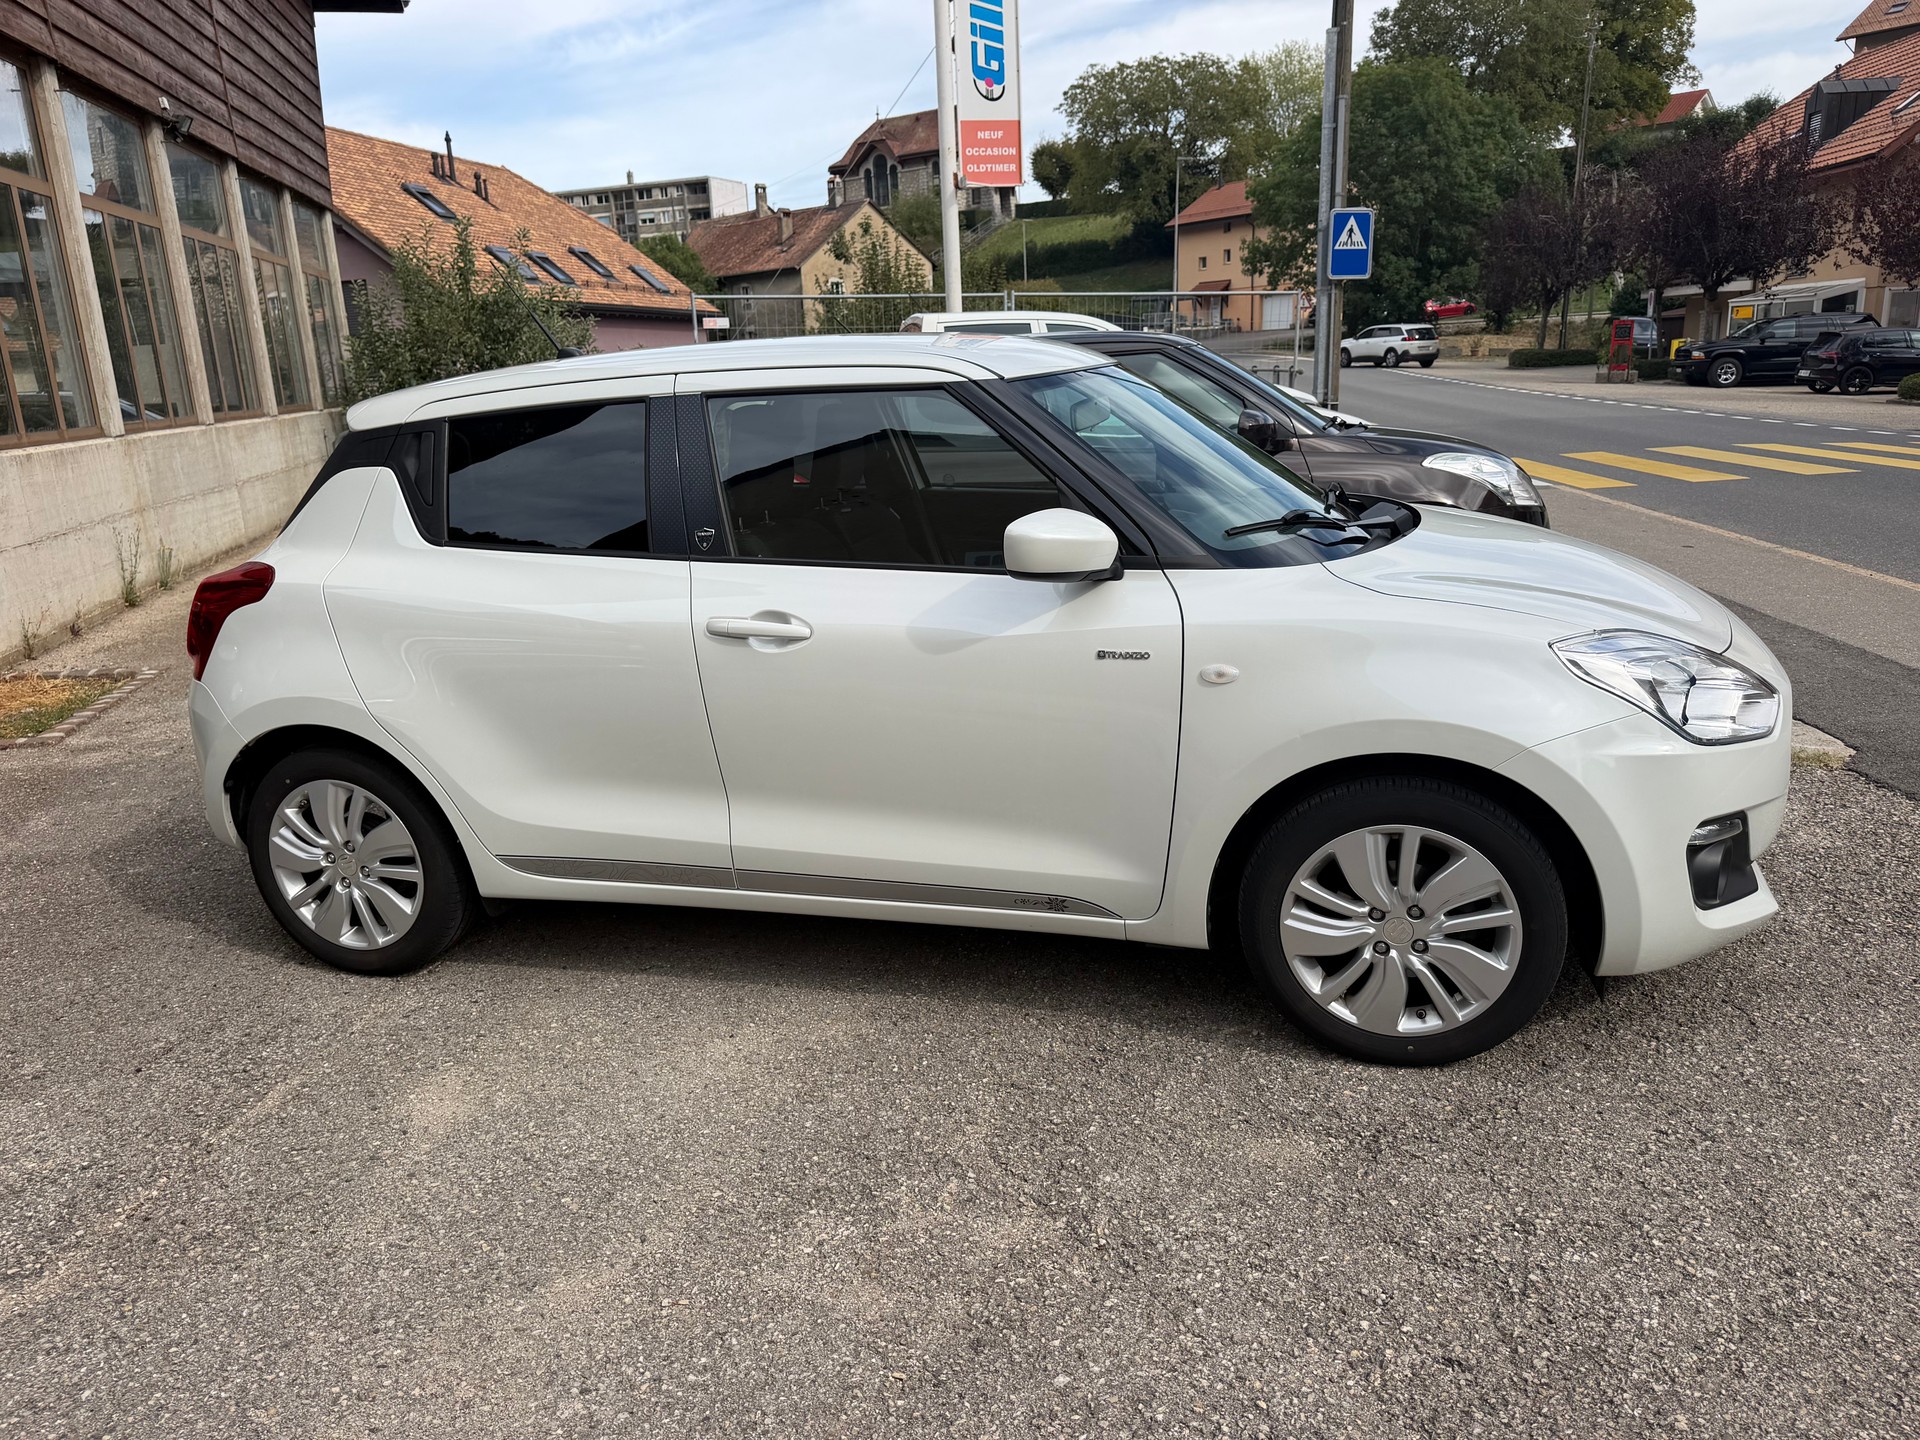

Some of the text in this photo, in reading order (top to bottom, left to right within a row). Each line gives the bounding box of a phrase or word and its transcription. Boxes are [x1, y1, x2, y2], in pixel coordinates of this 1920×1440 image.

[970, 0, 1005, 86] Gil
[977, 130, 1004, 139] NEUF
[965, 147, 1016, 156] OCCASION
[966, 163, 1016, 172] OLDTIMER
